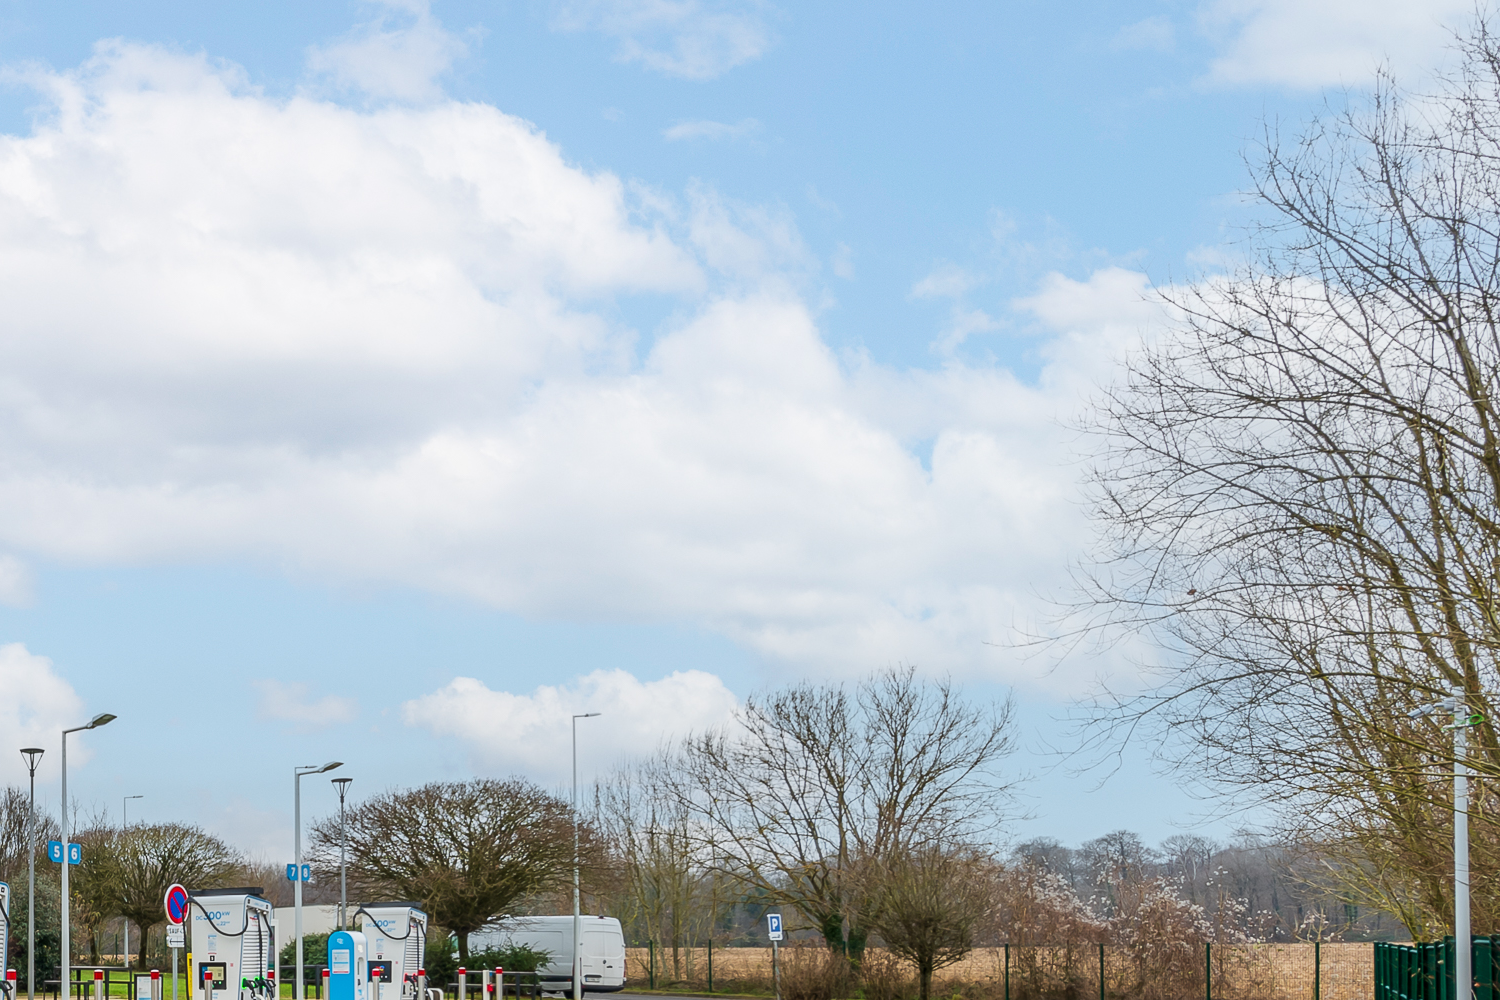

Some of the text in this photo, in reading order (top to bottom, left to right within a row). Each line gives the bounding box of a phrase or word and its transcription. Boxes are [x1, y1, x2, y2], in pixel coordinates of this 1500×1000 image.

[53, 845, 61, 858] 5
[71, 847, 78, 860] 6
[291, 867, 296, 877] 7
[303, 867, 308, 878] 8
[771, 918, 778, 930] P
